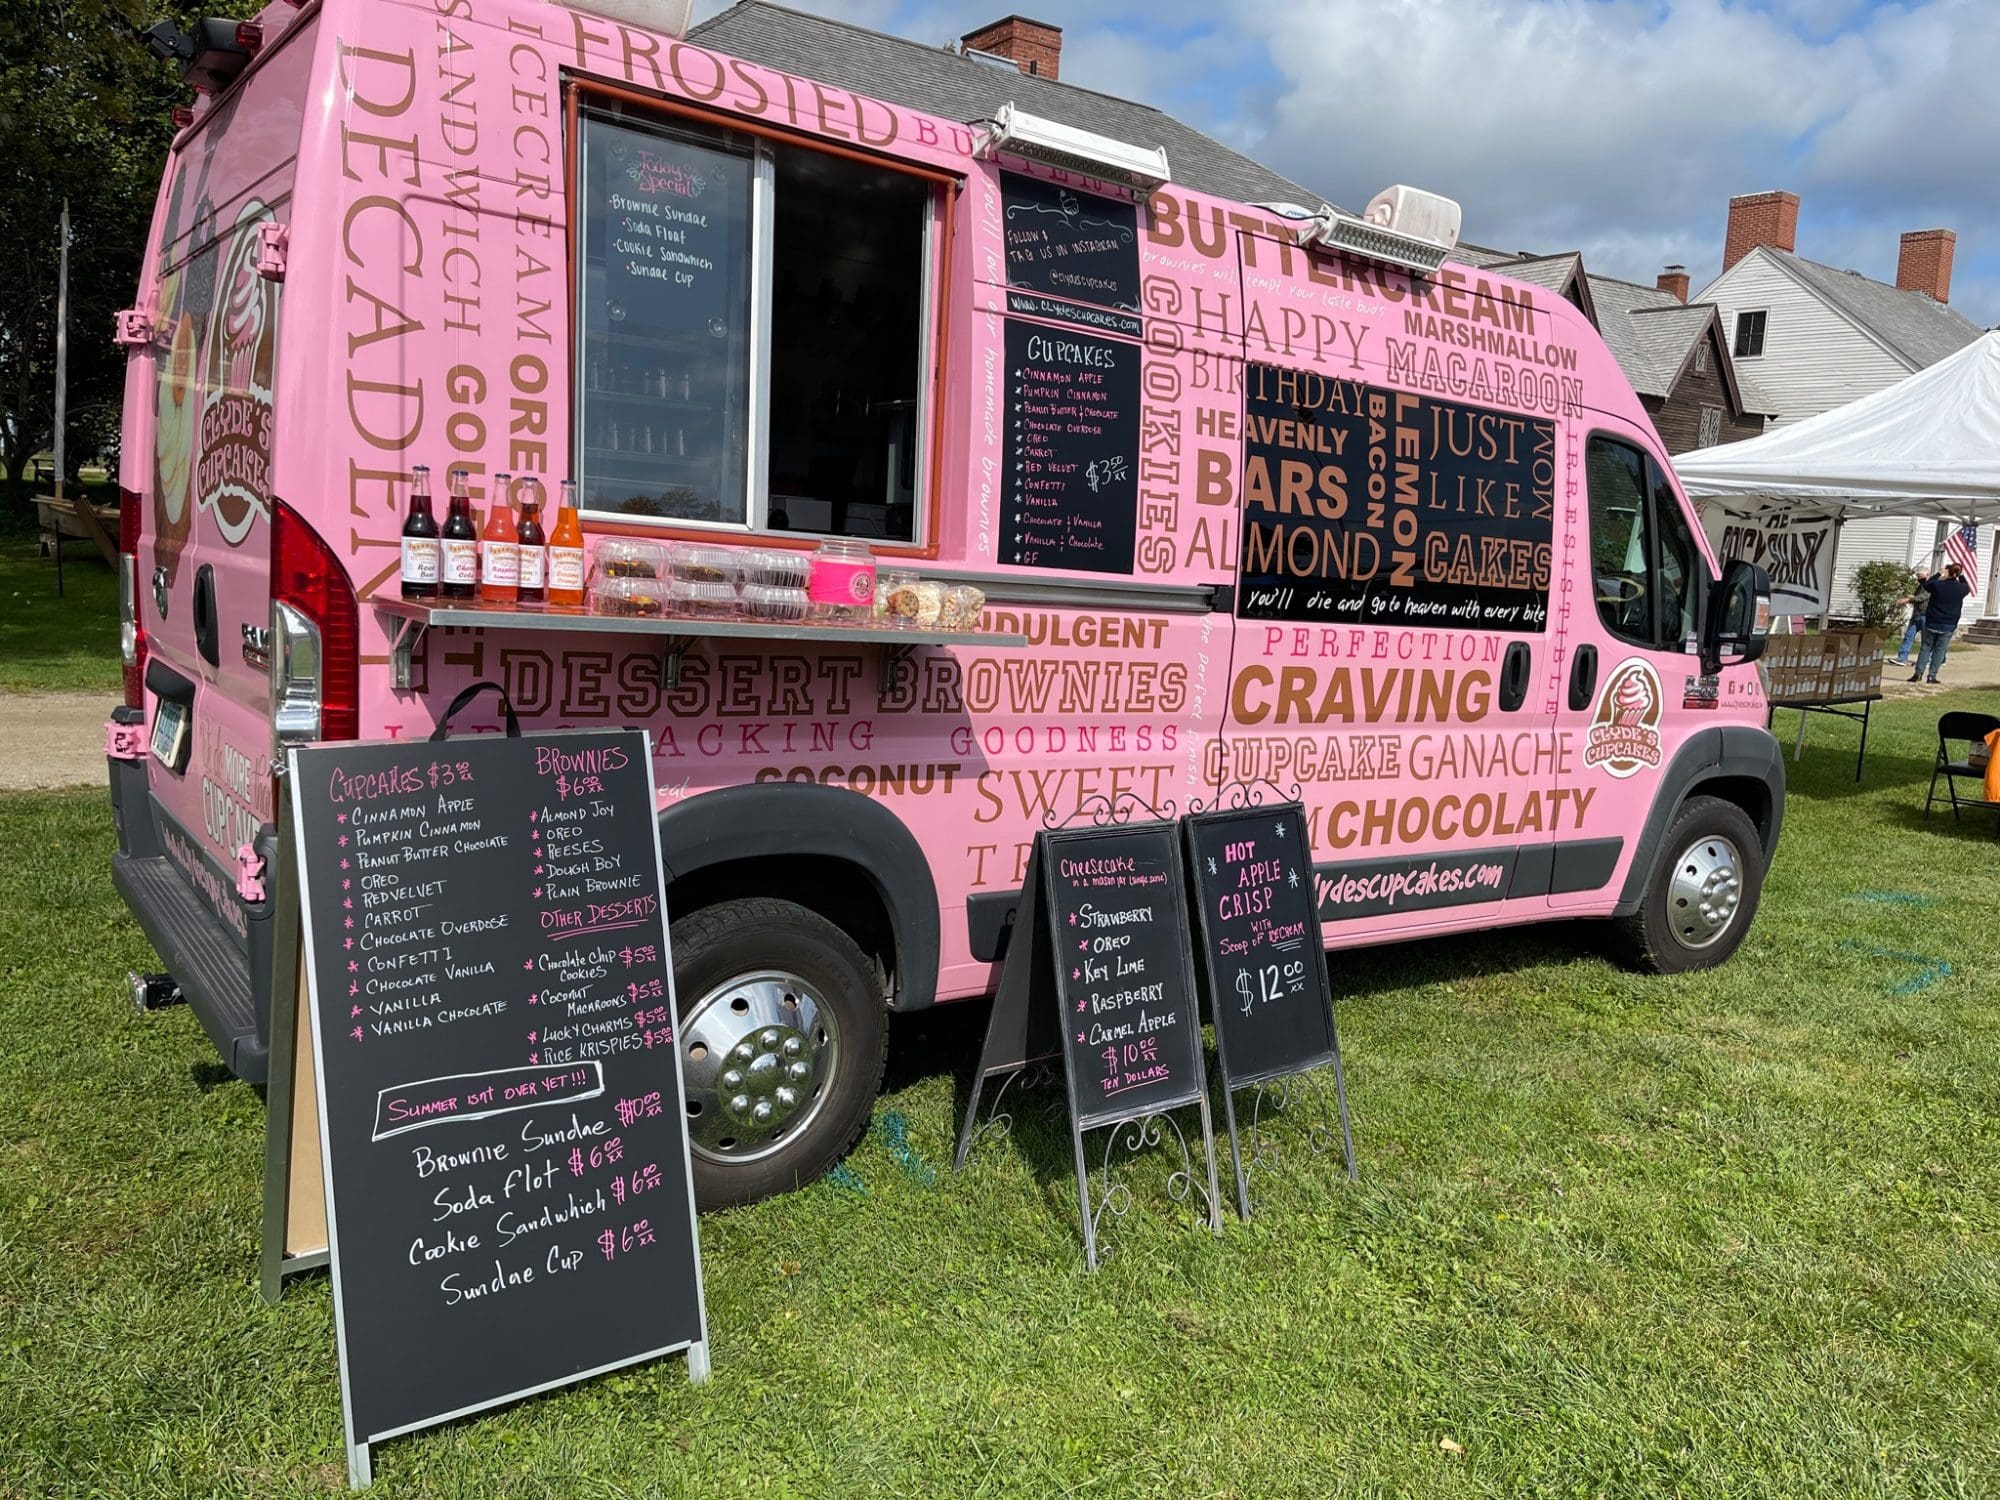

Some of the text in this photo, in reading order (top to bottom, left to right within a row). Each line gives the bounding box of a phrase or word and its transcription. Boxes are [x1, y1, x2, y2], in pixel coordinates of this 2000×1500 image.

[569, 11, 898, 147] FROSTED
[434, 0, 482, 337] SANDWICH
[625, 217, 686, 244] Soda Float
[665, 205, 708, 228] Sundae
[630, 261, 668, 280] Sundae
[1009, 248, 1034, 262] TAG
[1040, 245, 1053, 260] US
[1146, 191, 1536, 336] BUTTERCREAM
[1143, 249, 1205, 275] brownies
[1321, 287, 1352, 312] taste
[1190, 286, 1370, 372] HAPPY
[1403, 310, 1577, 371] MARSHMALLOW
[1027, 335, 1116, 369] CUPCAKES
[1022, 367, 1105, 385] CINNAMON APPLE
[1023, 385, 1107, 401] PUMPKIN CINNAMON
[1190, 346, 1369, 418] BIRTHDAY
[1385, 337, 1584, 419] MACAROON
[983, 347, 998, 447] homemade
[203, 399, 272, 451] CLYDE'S
[1138, 274, 1182, 574] COOKIES
[1196, 406, 1349, 456] HEAVENLY
[1429, 405, 1525, 465] JUST
[1024, 462, 1042, 473] RED
[1366, 394, 1388, 528] BACON
[1531, 420, 1555, 522] MOM
[1197, 449, 1349, 520] BARS
[1390, 392, 1421, 587] LEMON
[1429, 471, 1521, 519] LIKE
[978, 456, 998, 555] brownies
[1184, 517, 1381, 582] ALMOND
[1424, 531, 1553, 592] CAKES
[1545, 432, 1579, 716] IRRESISTIBLE
[1306, 591, 1334, 611] die
[1337, 593, 1364, 612] and
[1404, 598, 1448, 618] heaven
[1451, 598, 1480, 619] with
[1483, 605, 1518, 623] every
[1521, 601, 1546, 622] bite
[1201, 616, 1216, 645] the
[1263, 626, 1502, 663] PERFECTION
[497, 648, 1189, 718] DESSERT BROWNIES
[1192, 652, 1209, 720] perfect
[1231, 664, 1492, 726] CRAVING
[952, 723, 1180, 757] GOODNESS
[1590, 725, 1658, 747] CLYDE'S
[534, 746, 629, 776] BROWNIES
[1202, 731, 1573, 787] CUPCAKE GANACHE
[1585, 743, 1661, 765] CUPCAKES
[329, 766, 424, 802] CUPCAKES
[974, 765, 1175, 823] SWEET
[352, 794, 475, 825] CINNAMON APPLE
[540, 800, 614, 823] ALMOND JOY
[1327, 786, 1598, 850] CHOCOLATY
[355, 819, 481, 847] PUMPKIN CINNAMON
[546, 826, 583, 840] OREO
[547, 839, 604, 860] REESES
[356, 835, 509, 870] PEANUT BUTTER CHOCOLATE
[545, 854, 621, 879] DOUGH BOY
[1224, 840, 1257, 864] HOT
[361, 874, 399, 890] OREO
[545, 874, 643, 900] PLAIN BROWNIE
[1237, 858, 1281, 888] APPLE
[365, 903, 433, 929] CARROT
[540, 894, 657, 928] OTHER DESSERTS
[1079, 903, 1153, 928] STRAWBERRY
[1219, 886, 1273, 921] CRISP
[360, 914, 511, 951] CHOCOLATE OVERDOSE
[1250, 918, 1272, 933] WITH
[367, 947, 453, 973] CONFETTI
[1093, 934, 1131, 954] OREO
[365, 961, 495, 995] CHOCOLATE VANILLA
[1084, 955, 1145, 985] KEY LIME
[369, 992, 442, 1016] VANILLA
[1091, 982, 1164, 1016] RASPBERRY
[371, 1000, 508, 1036] VANILLA CHOCOLATE
[581, 1017, 633, 1037] CHARMS
[1089, 1009, 1176, 1047] CARMEL APPLE
[544, 1032, 643, 1065] RICE KRISPIES
[1100, 1063, 1170, 1091] TEN DOLLARS
[387, 1081, 538, 1122] SUMMER OVER
[521, 1113, 612, 1152] Sundae
[433, 1185, 495, 1222] Soda
[409, 1187, 606, 1266] Cookie Sandwhich
[440, 1260, 536, 1305] Sundae
